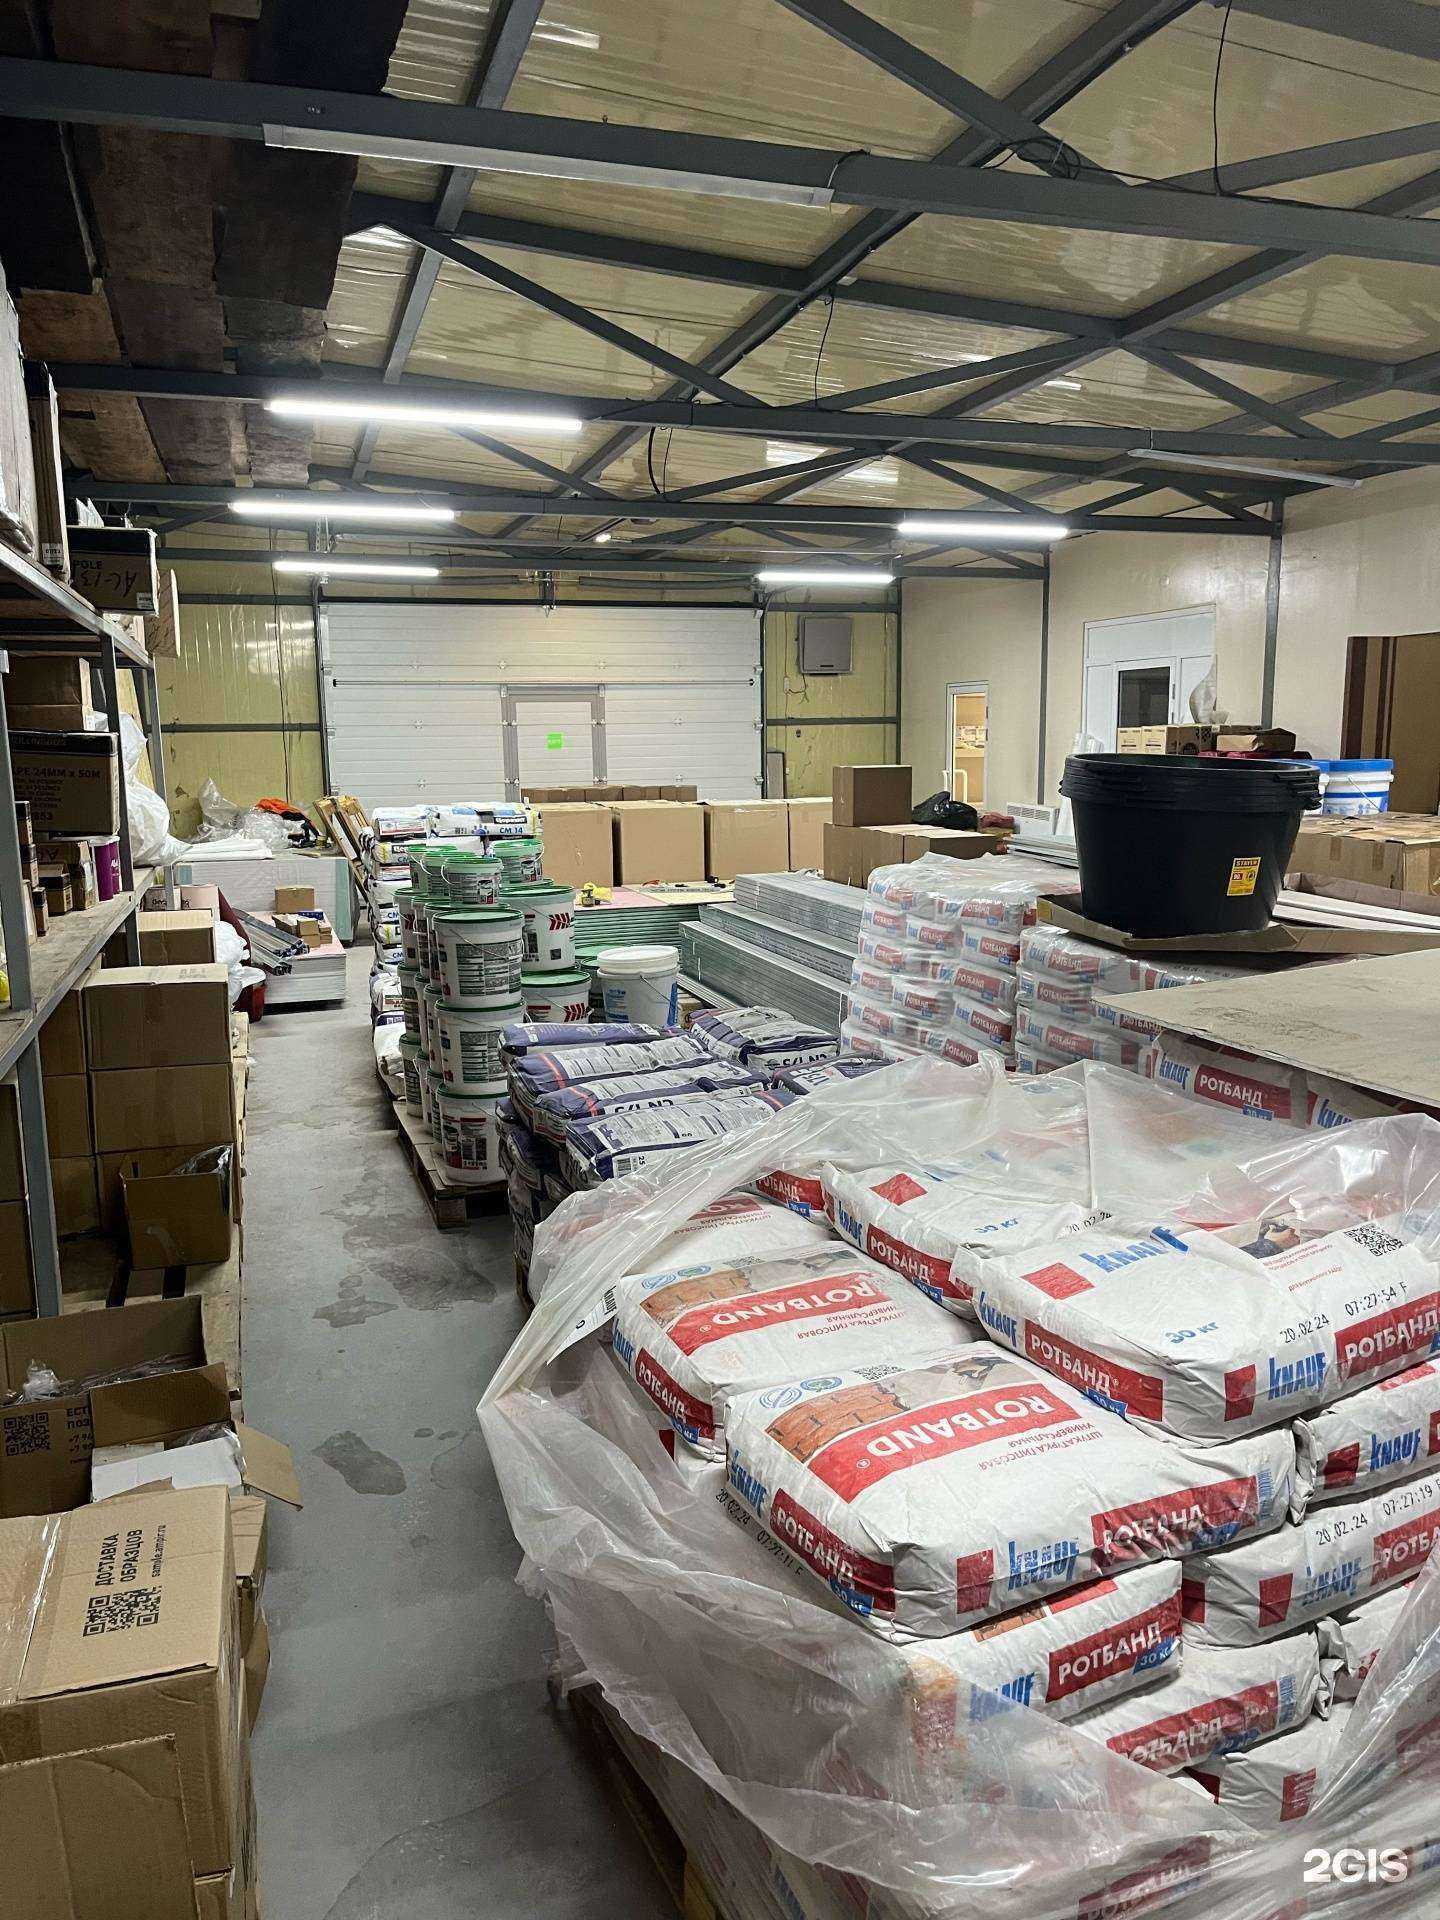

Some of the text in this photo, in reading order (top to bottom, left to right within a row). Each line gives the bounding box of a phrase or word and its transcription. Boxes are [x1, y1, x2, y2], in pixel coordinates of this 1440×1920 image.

[1158, 1052, 1191, 1090] KNAUF
[1199, 1074, 1265, 1108] РОТБАНД
[870, 1235, 931, 1285] РОТБАНД
[711, 1278, 880, 1328] ROTBAND
[1344, 1285, 1397, 1317] 07:27:54
[1164, 1321, 1219, 1344] 30 кг
[1343, 1307, 1440, 1363] РОТБАНД
[1030, 1334, 1112, 1398] РОТБАНД
[1267, 1350, 1328, 1402] KNAUF
[866, 1396, 1057, 1458] ROTBAND
[1369, 1427, 1421, 1473] KNAUF
[1315, 1512, 1369, 1546] 20.02.24
[1382, 1484, 1434, 1516] 07:27:19
[95, 1533, 119, 1587] ДОСТАВКА
[120, 1529, 144, 1583] ОБРАЗЦОВ
[776, 1506, 856, 1591] РОТБАНД
[1058, 1621, 1162, 1686] РОТБАНД
